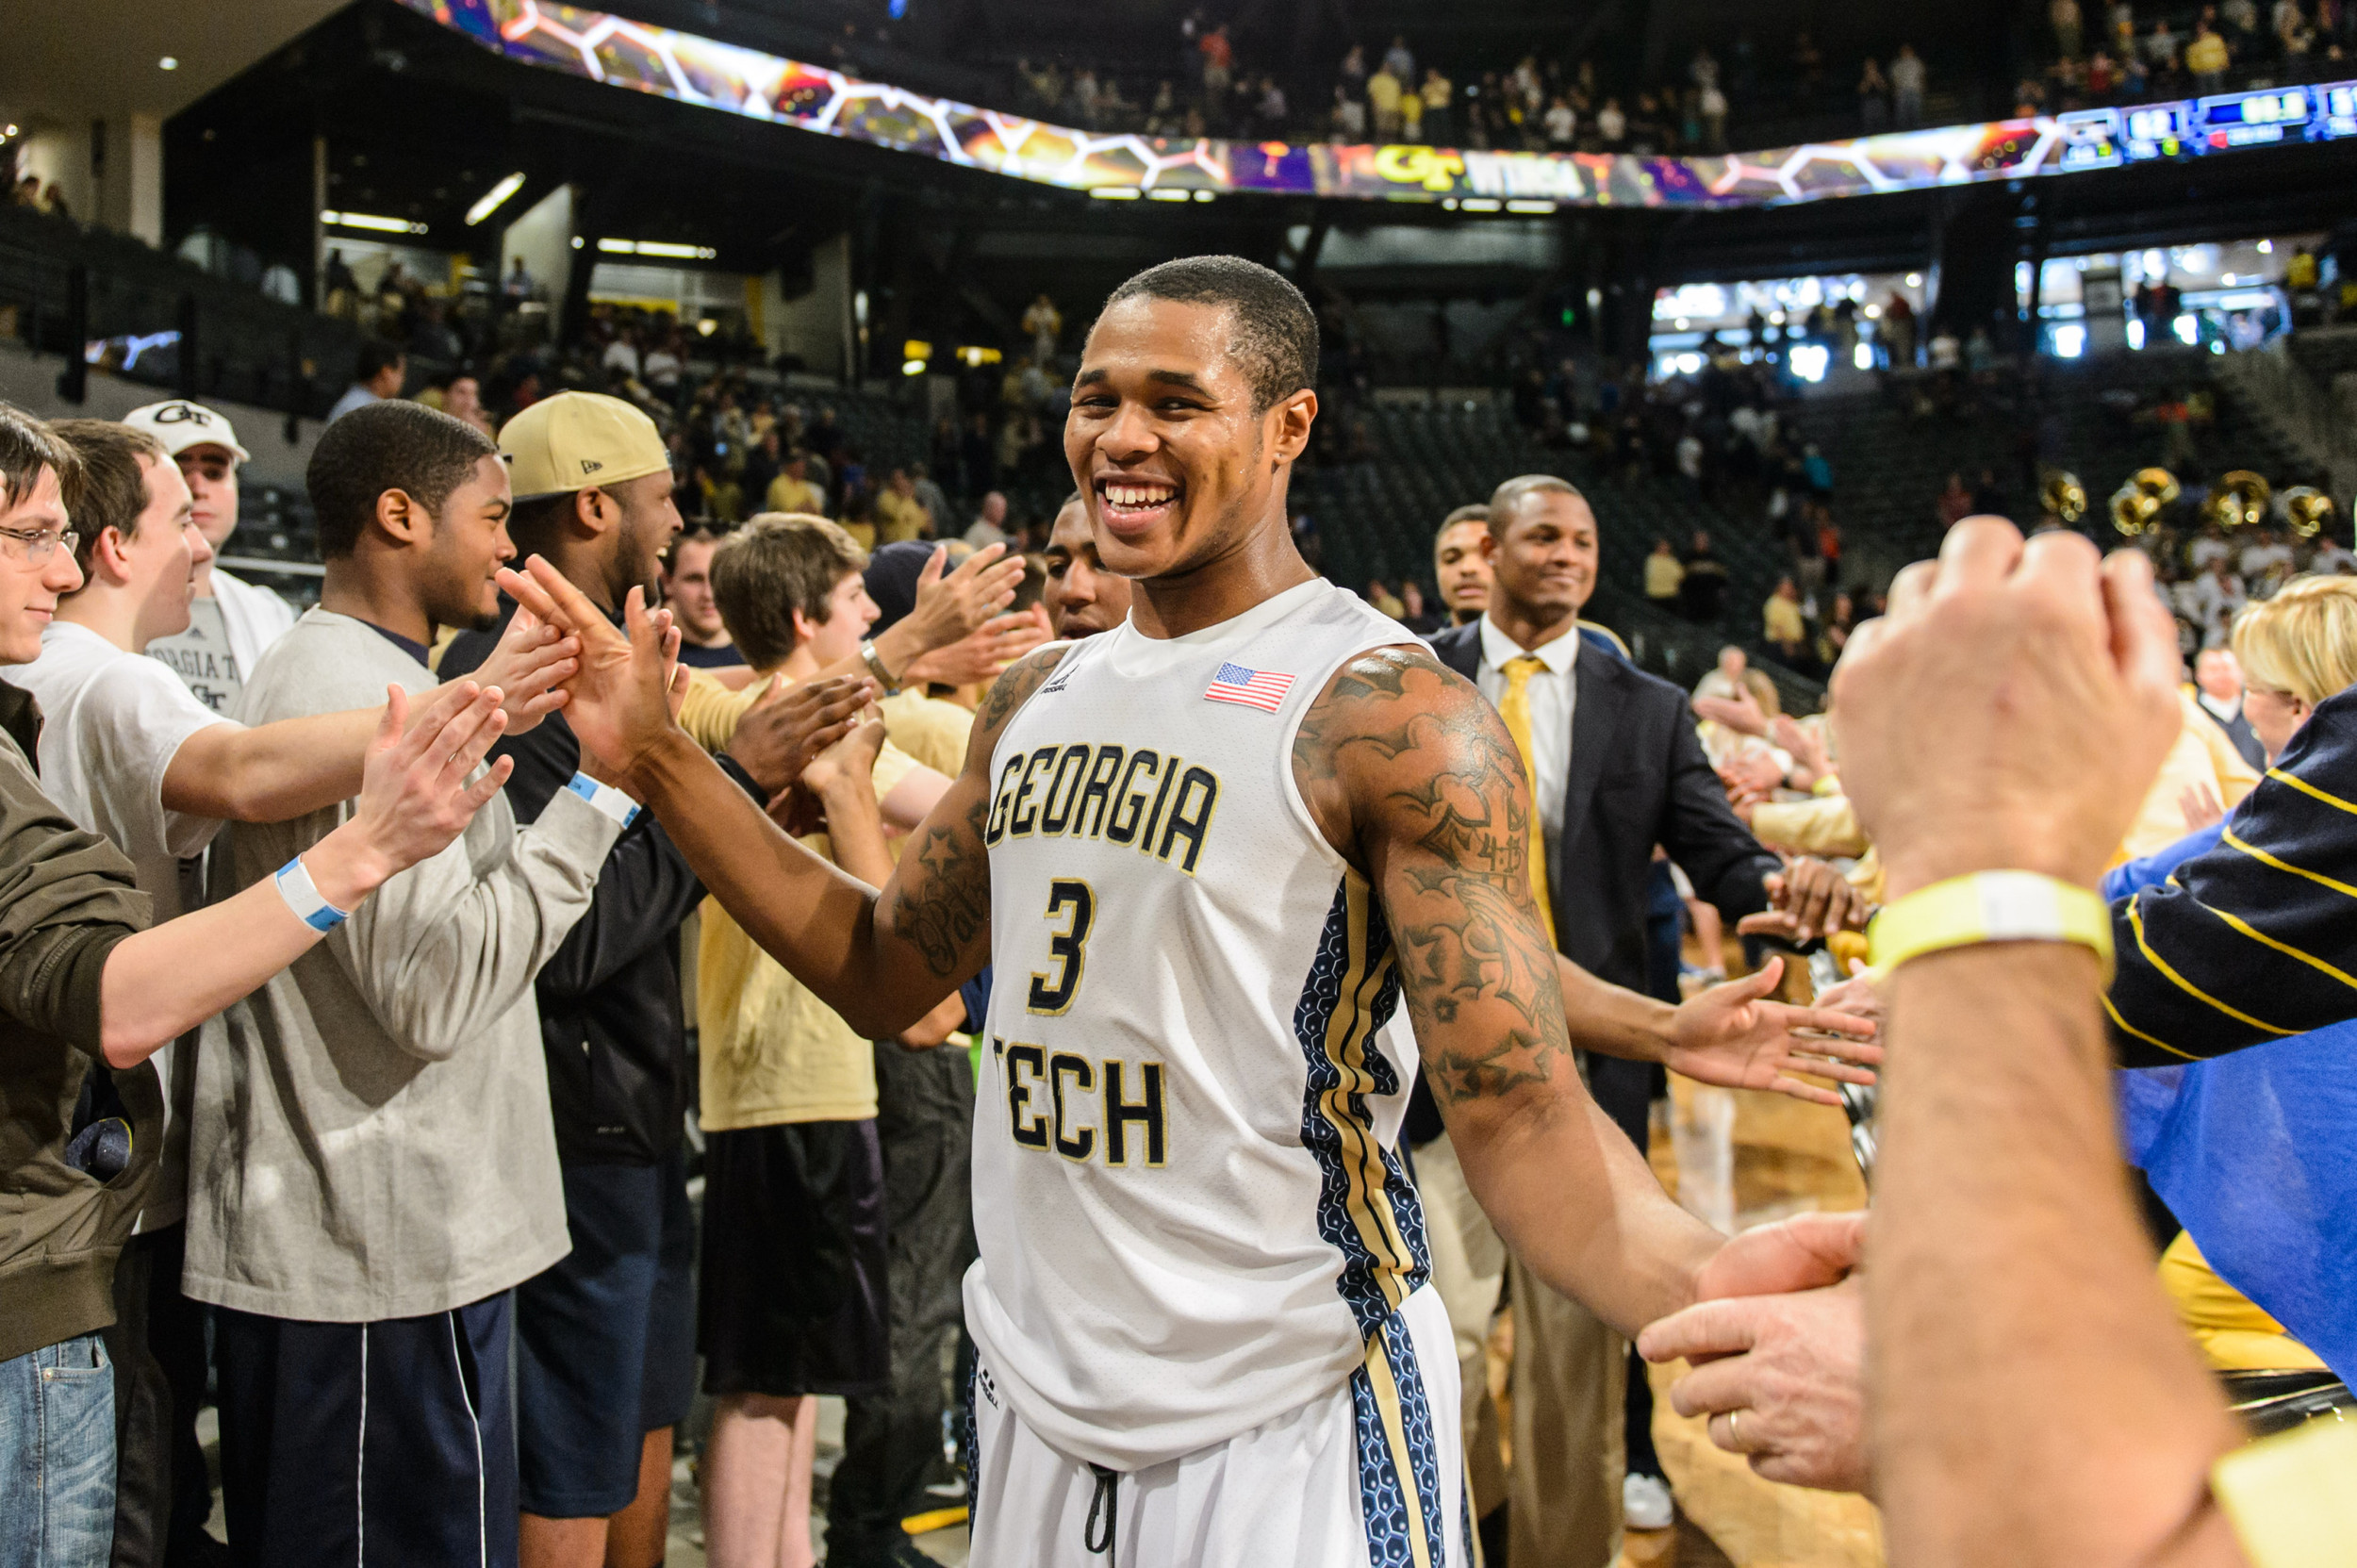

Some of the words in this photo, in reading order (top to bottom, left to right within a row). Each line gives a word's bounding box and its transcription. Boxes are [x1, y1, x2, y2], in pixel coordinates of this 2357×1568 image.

[155, 404, 212, 428] GT
[985, 742, 1223, 878] GEORGIA
[1027, 877, 1098, 1017] 3
